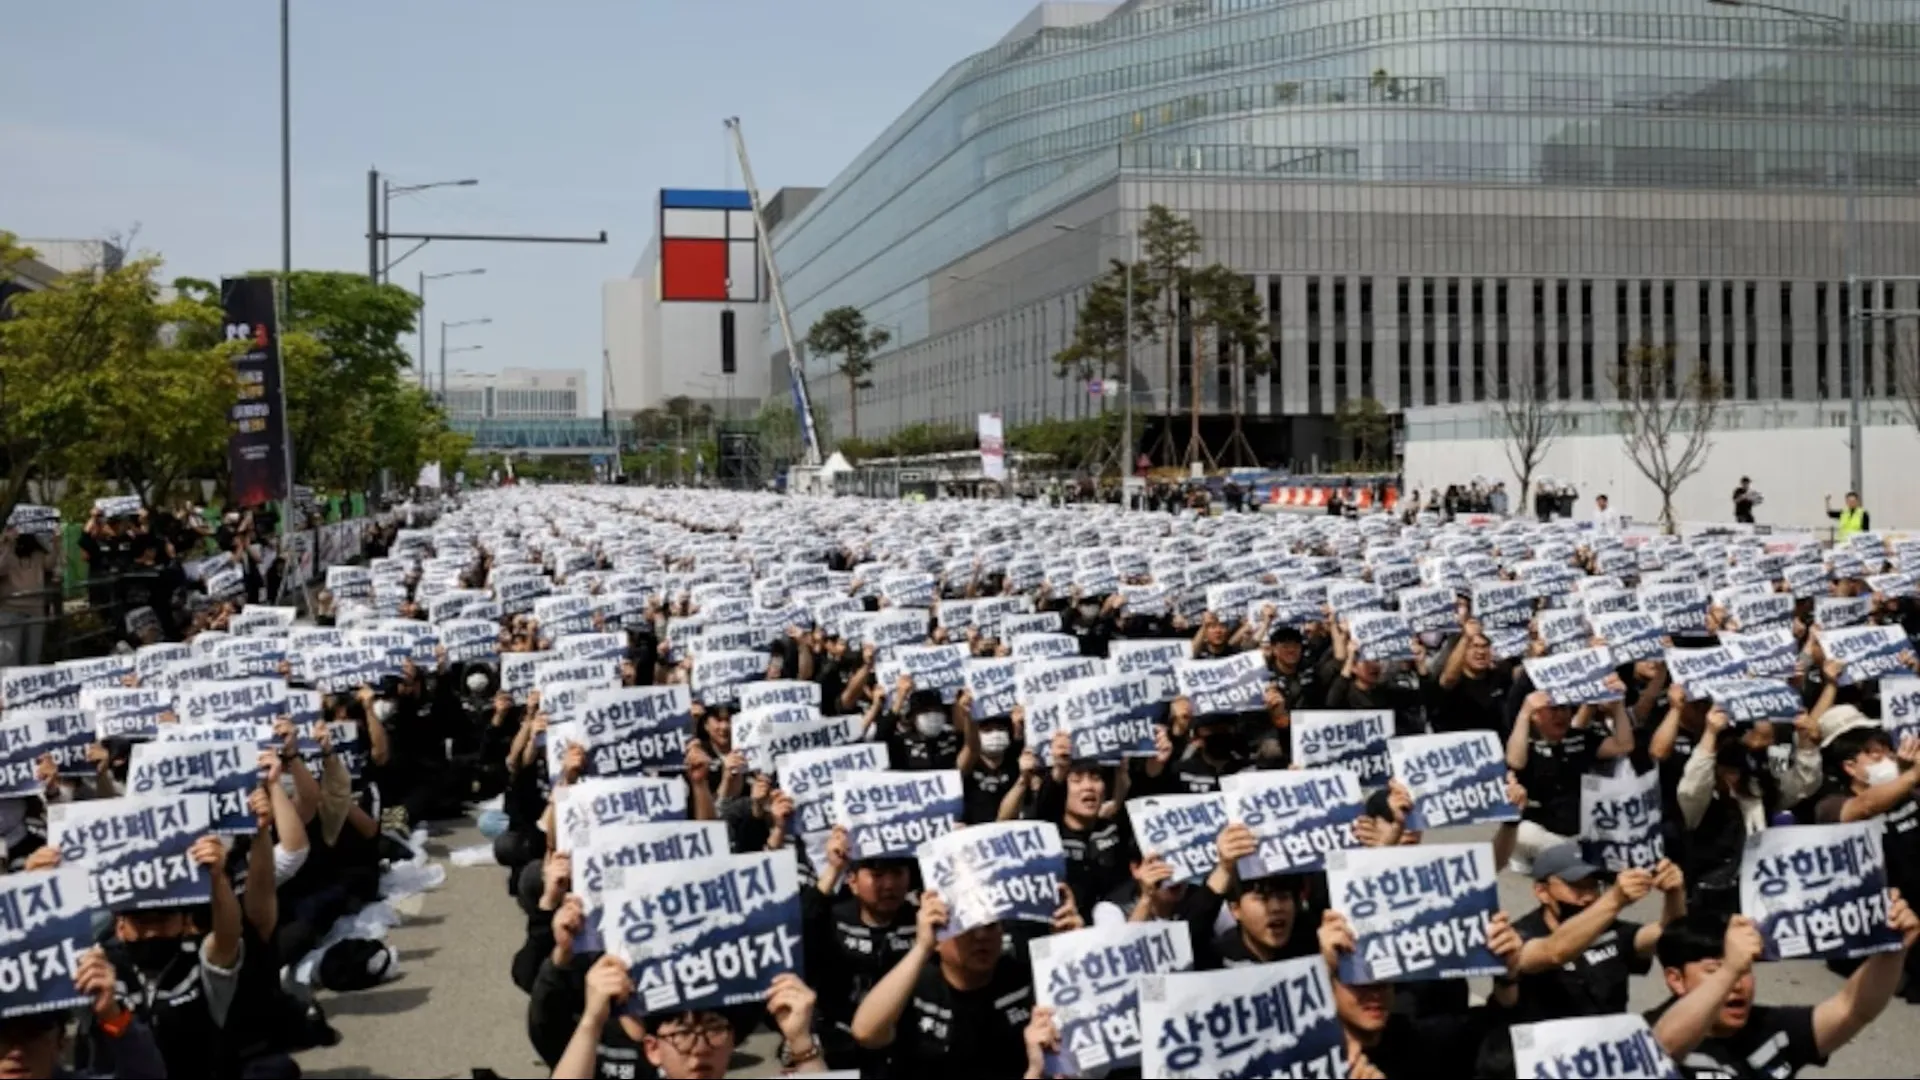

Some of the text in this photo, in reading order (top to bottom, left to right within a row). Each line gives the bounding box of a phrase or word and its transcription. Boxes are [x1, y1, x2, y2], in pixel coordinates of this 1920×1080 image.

[505, 661, 534, 682] 상한
[971, 661, 1017, 690] 상한폐
[1023, 660, 1096, 694] 상한폐지
[1117, 643, 1183, 674] 상한폐지
[1183, 653, 1254, 687] 상한폐지
[97, 691, 160, 711] 한폐지
[187, 682, 273, 717] 상한폐지
[543, 690, 576, 715] 상한
[583, 689, 676, 736] 상한폐지
[702, 682, 741, 703] 실현
[980, 691, 1017, 717] 실현
[1065, 680, 1148, 721] 상한폐지
[46, 713, 87, 736] 폐지
[104, 715, 157, 733] 현하자
[1075, 717, 1157, 757] 실현하자
[1300, 716, 1384, 755] 상한폐지
[50, 743, 90, 768] 하자
[135, 746, 241, 791] 상한폐지
[594, 730, 689, 775] 실현하자
[788, 751, 876, 793] 상한폐지
[1402, 736, 1493, 787] 상한폐지
[563, 782, 672, 833] 상한폐지
[843, 776, 947, 814] 상한폐지
[1238, 775, 1347, 825] 상한폐지
[1420, 776, 1511, 828] 실현하자
[59, 800, 191, 861] 상한폐지
[856, 815, 954, 857] 실현하자
[583, 827, 713, 890] 상한폐지
[1166, 844, 1220, 880] 실현
[1752, 828, 1876, 896] 상한폐지
[619, 858, 776, 943] 상한폐지
[981, 873, 1060, 910] 현하자
[1343, 849, 1480, 918] 상한폐지
[1772, 887, 1892, 958] 실현하자
[0, 937, 90, 993] 하자
[1365, 911, 1492, 980] 실현하자
[637, 925, 802, 1012] 실현하자
[1048, 928, 1177, 1006] 상한폐지
[1068, 1006, 1141, 1070] 실현
[1157, 965, 1327, 1070] 상한폐지
